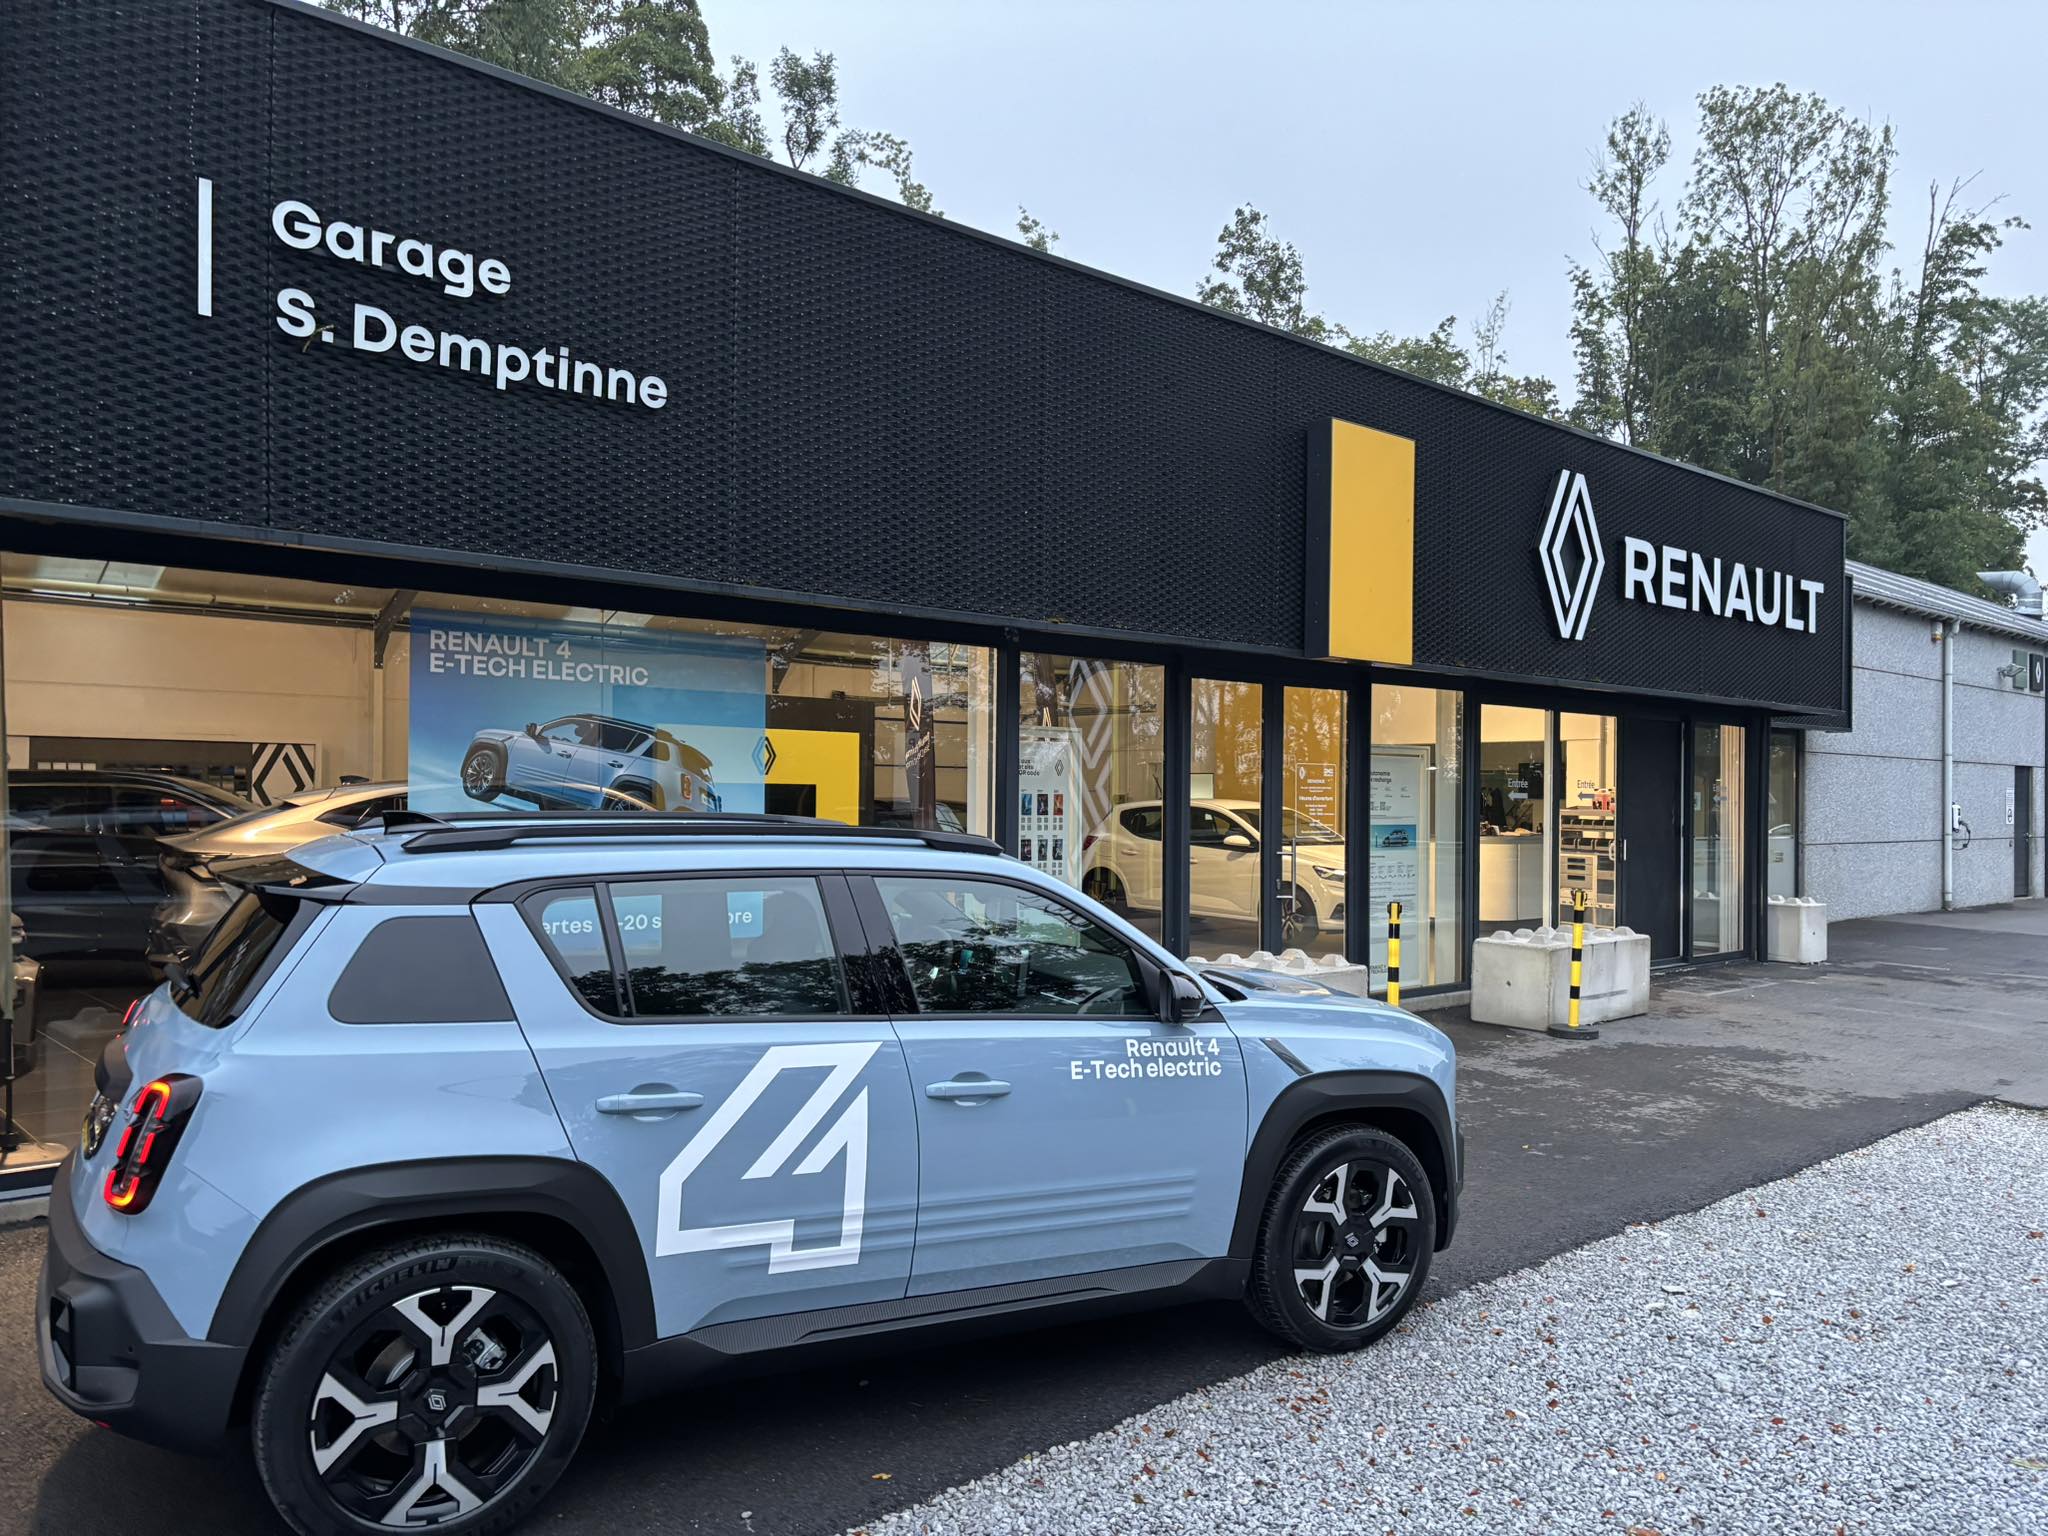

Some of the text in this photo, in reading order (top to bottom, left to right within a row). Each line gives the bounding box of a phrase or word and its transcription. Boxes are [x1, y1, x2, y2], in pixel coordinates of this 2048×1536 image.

[272, 200, 511, 297] Garage
[276, 287, 668, 409] S. Demptinne
[1625, 536, 1824, 633] RENAULT
[430, 629, 571, 659] RENAULT 4
[430, 653, 648, 686] E-TECH ELECTRIC
[1508, 778, 1529, 789] Entrée
[1577, 779, 1595, 789] Entrée
[543, 919, 593, 935] ertes
[1126, 1037, 1220, 1057] Renault 4
[1071, 1056, 1222, 1080] E-Tech electric
[656, 1041, 883, 1274] 4
